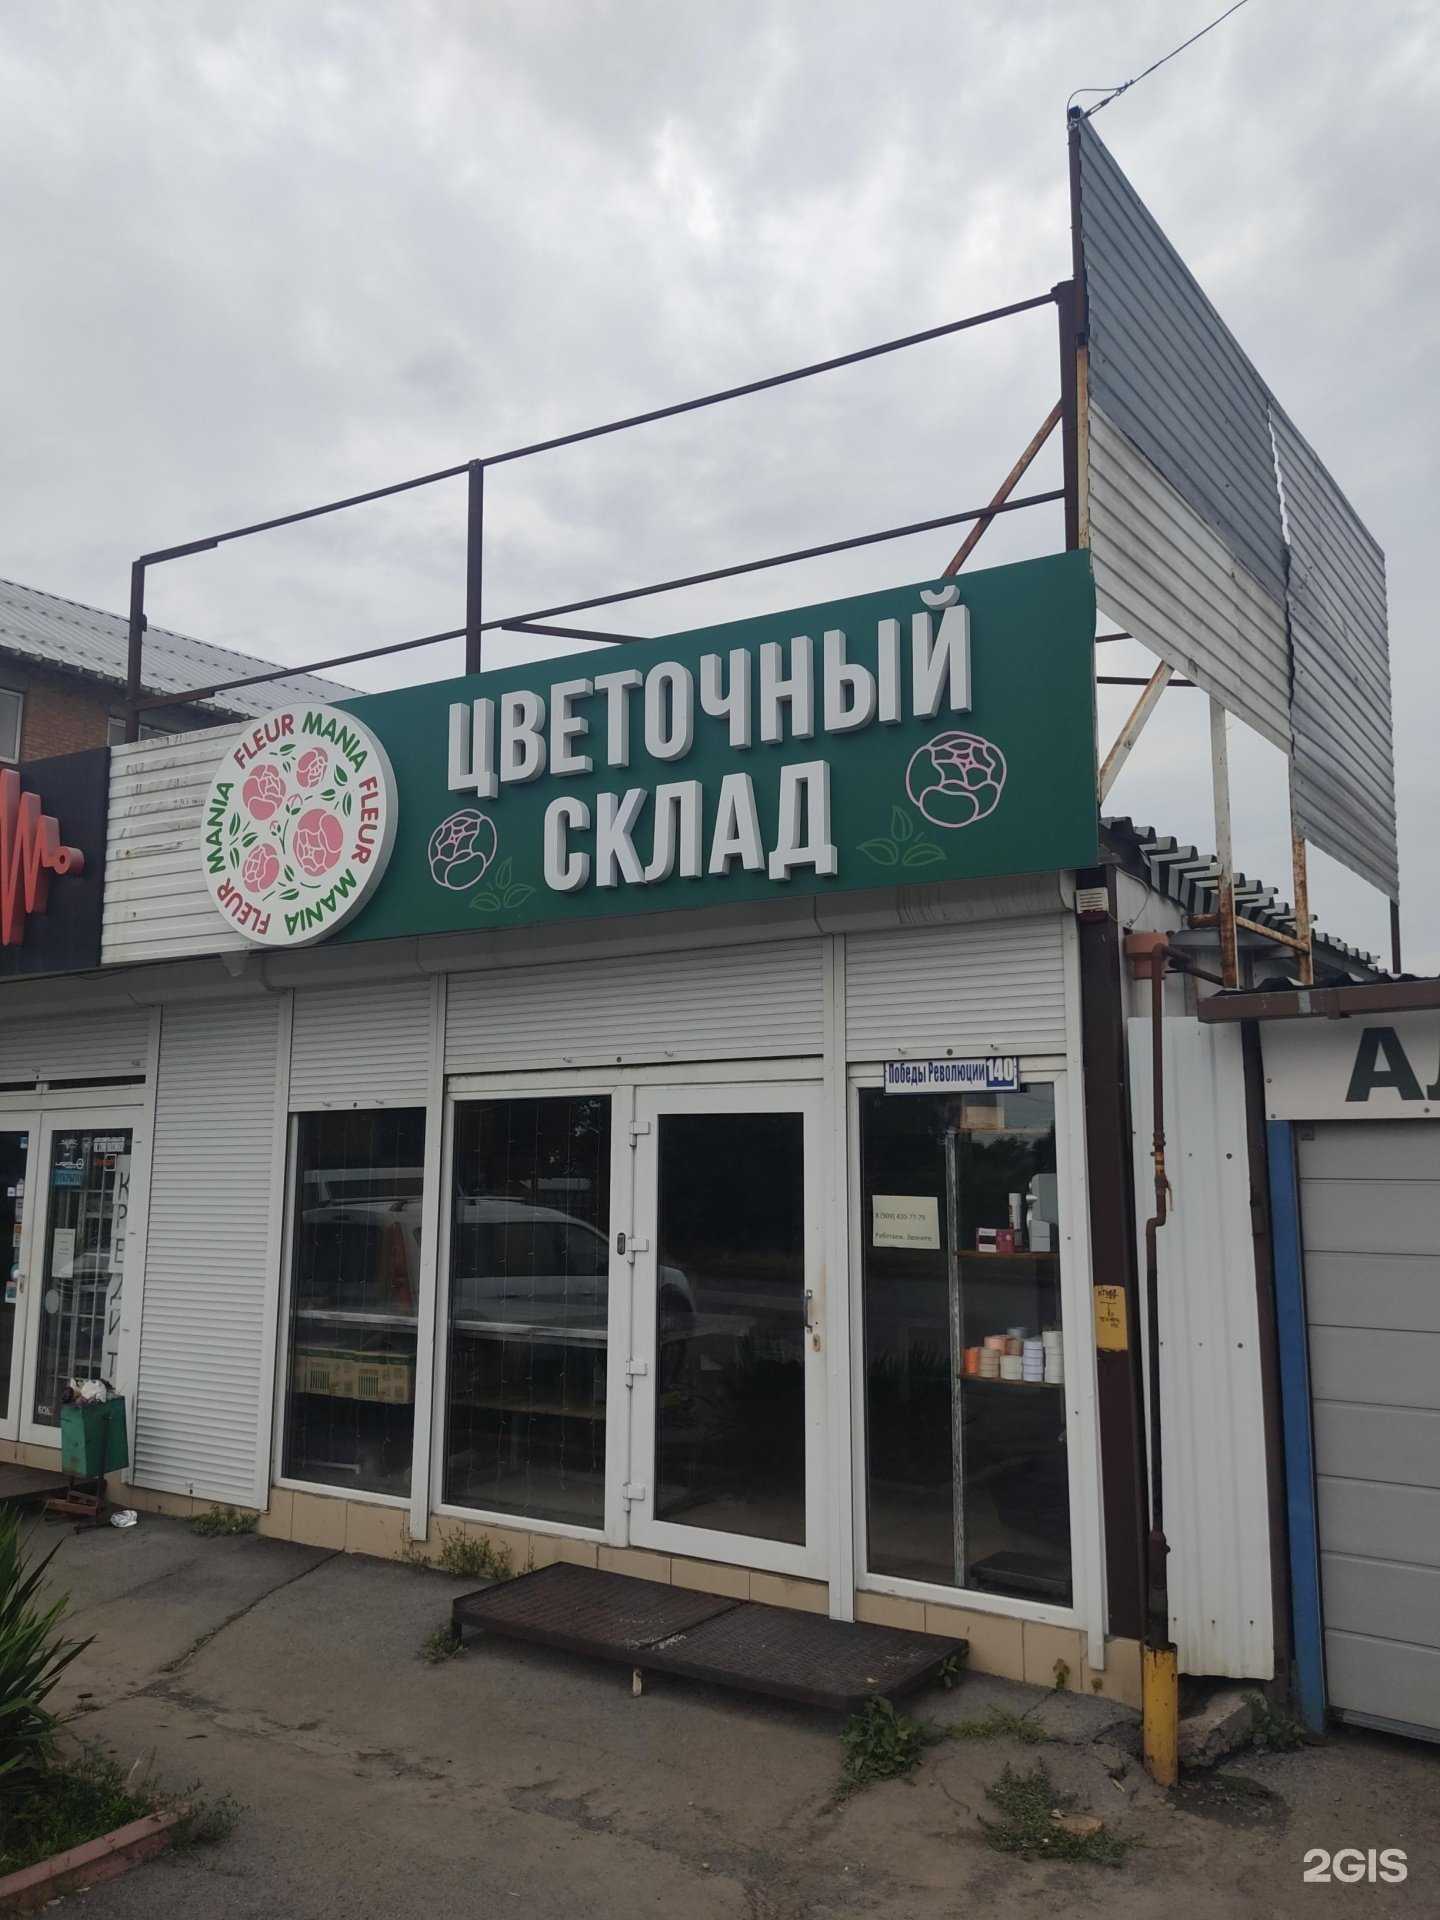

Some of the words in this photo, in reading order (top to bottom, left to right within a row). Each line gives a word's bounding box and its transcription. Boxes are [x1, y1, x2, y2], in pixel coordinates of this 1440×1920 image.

[448, 584, 972, 799] ЦВЕТОЧНЫЙ
[233, 713, 294, 769] FLEUR
[302, 711, 368, 773] MANIA
[206, 782, 234, 874] MANIA
[351, 776, 379, 865] FLEUR
[544, 760, 838, 893] СКЛАД
[216, 877, 271, 935] FLEUR
[284, 868, 357, 935] MANIA
[888, 1063, 927, 1086] Победы
[928, 1061, 985, 1085] Революции
[986, 1057, 1014, 1082] 140
[1345, 1026, 1440, 1102] А
